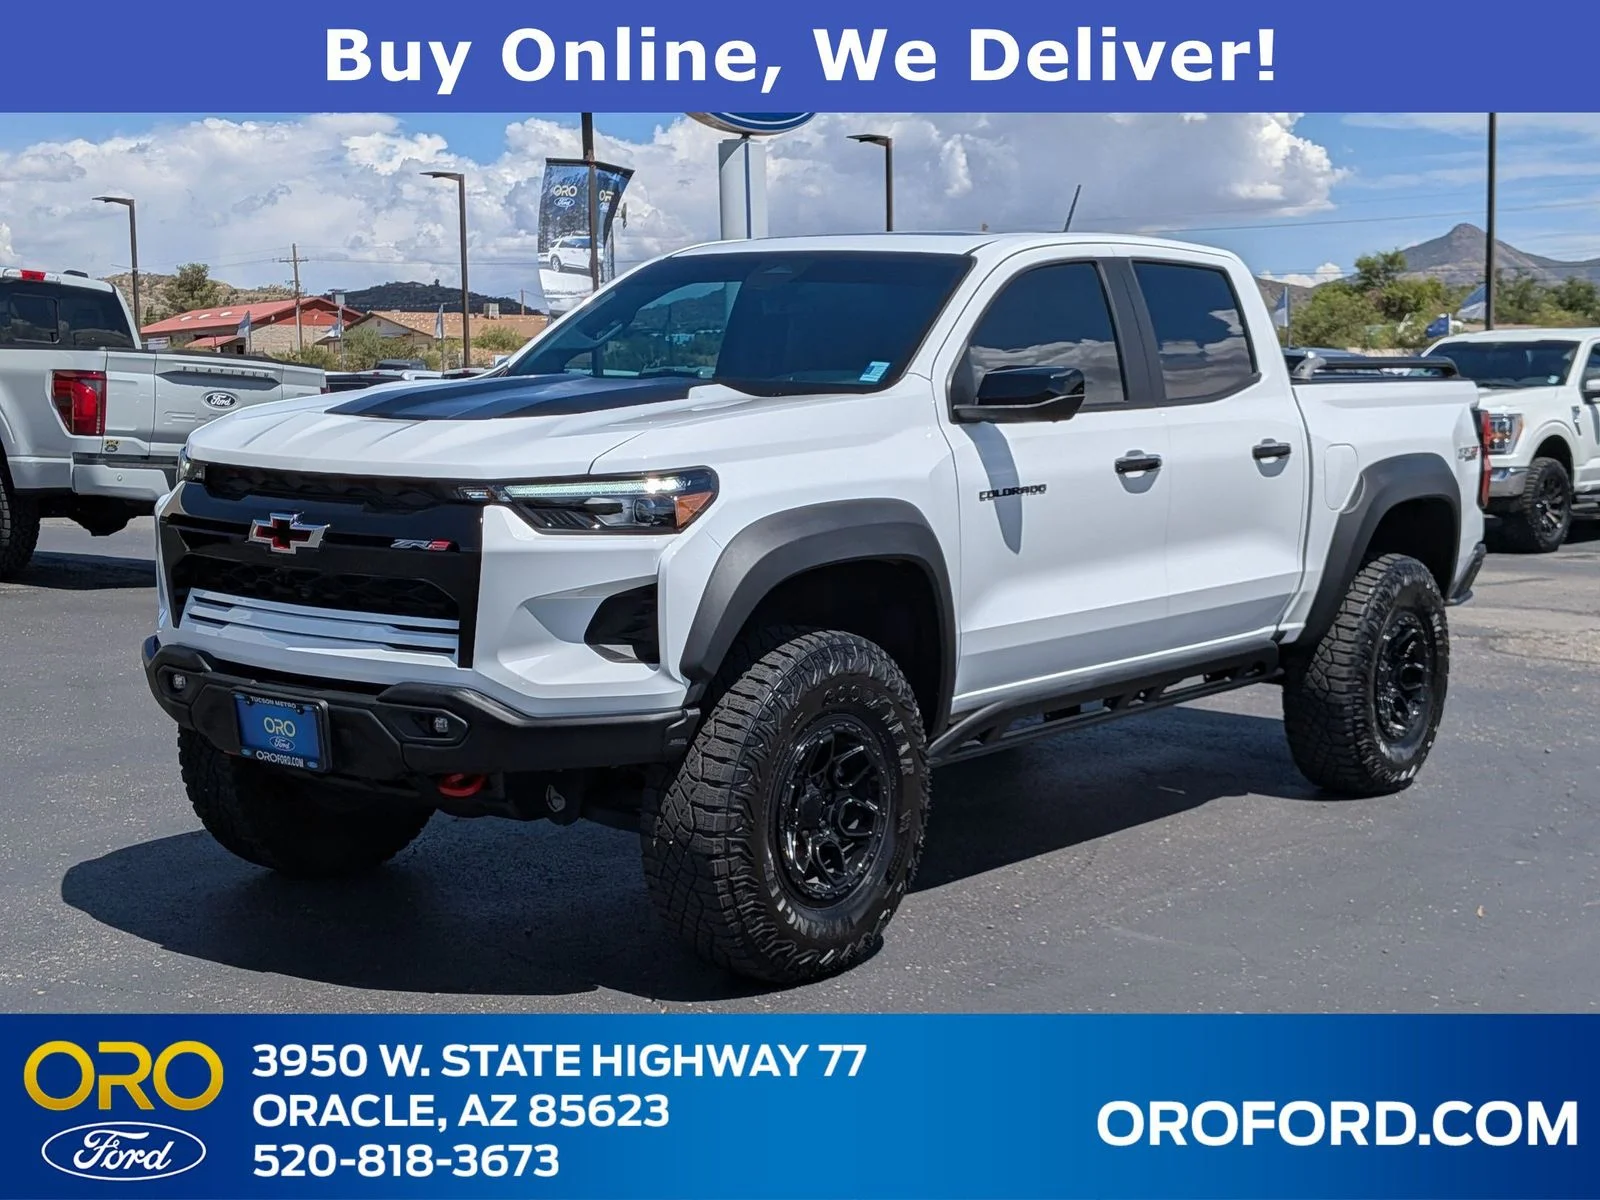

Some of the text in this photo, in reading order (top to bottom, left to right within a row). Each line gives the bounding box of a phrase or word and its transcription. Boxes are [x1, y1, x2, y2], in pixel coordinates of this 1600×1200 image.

[554, 185, 577, 197] ORO
[210, 394, 232, 406] Ford
[979, 484, 1047, 501] COLORADO
[275, 700, 297, 709] METRO
[264, 717, 296, 737] ORO
[273, 738, 291, 750] Ford
